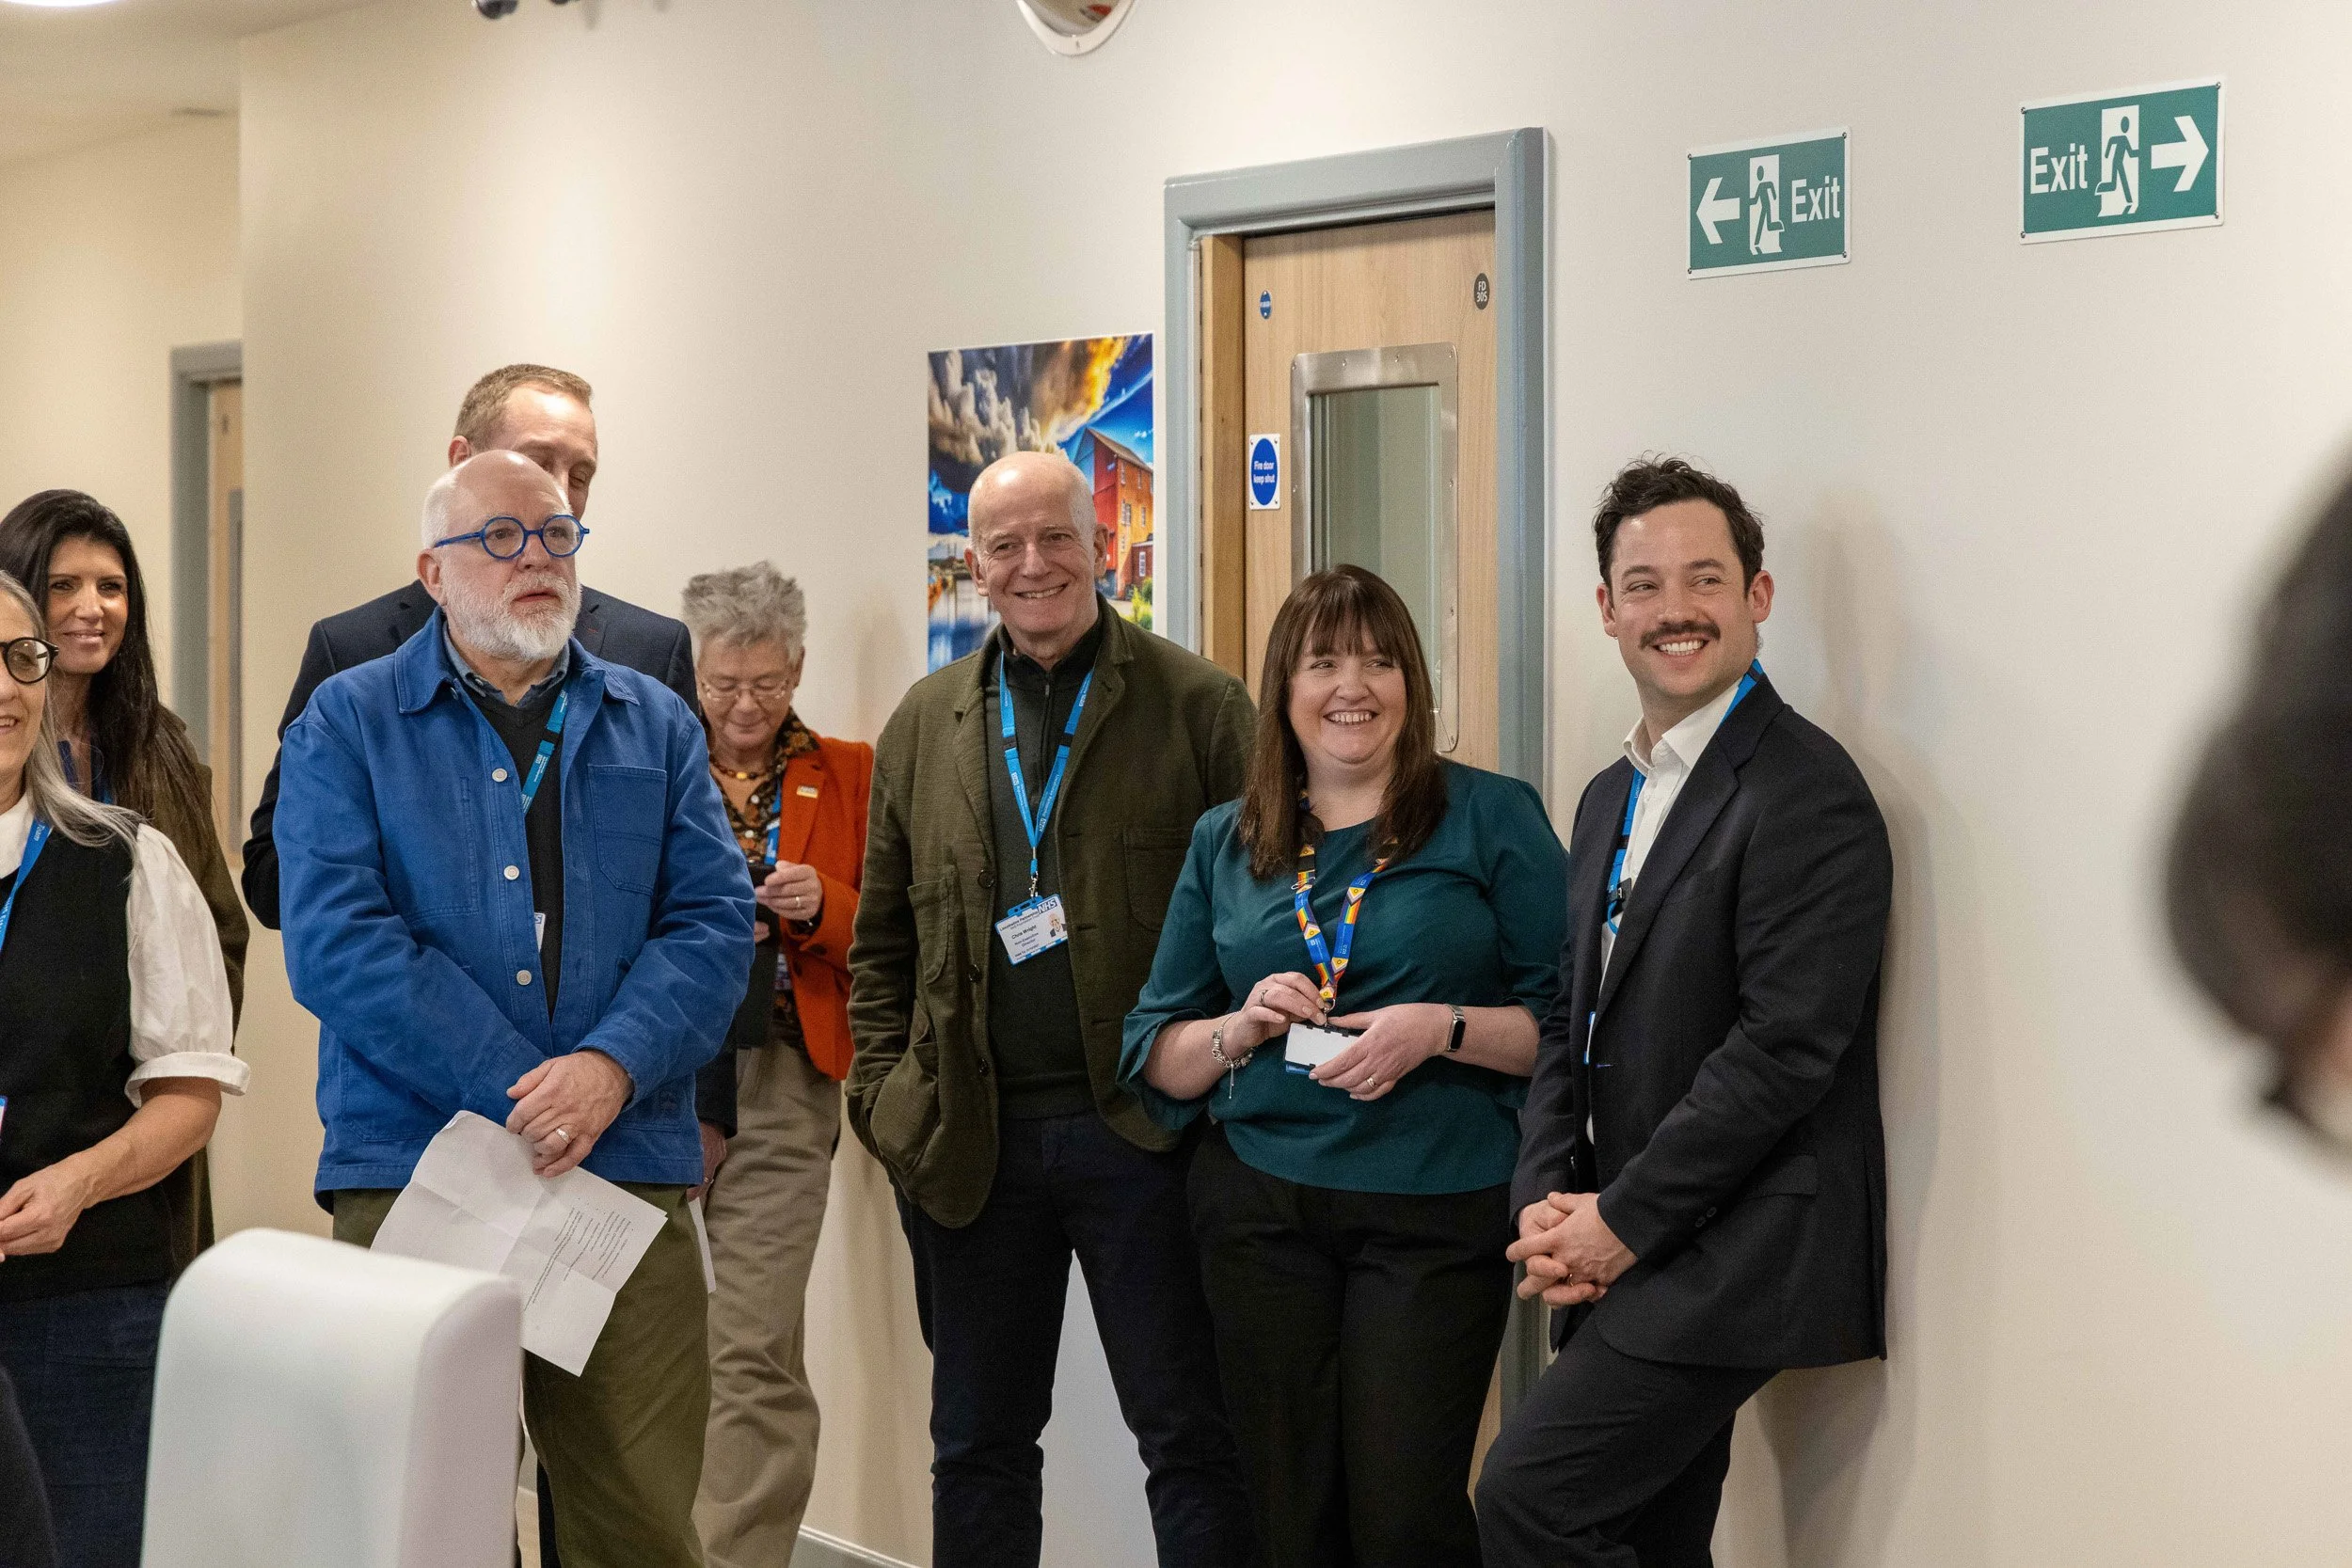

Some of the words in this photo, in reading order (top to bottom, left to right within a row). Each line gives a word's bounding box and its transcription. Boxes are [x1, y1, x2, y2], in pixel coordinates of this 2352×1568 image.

[2029, 143, 2089, 195] Exit
[1791, 175, 1841, 224] Exit
[1478, 280, 1486, 292] FD
[1253, 460, 1263, 470] Fire
[1263, 460, 1275, 470] door
[1253, 474, 1264, 485] keep
[1264, 473, 1276, 483] shut
[1038, 898, 1057, 914] NHS
[1011, 931, 1023, 940] Chris
[1023, 925, 1037, 934] Wright
